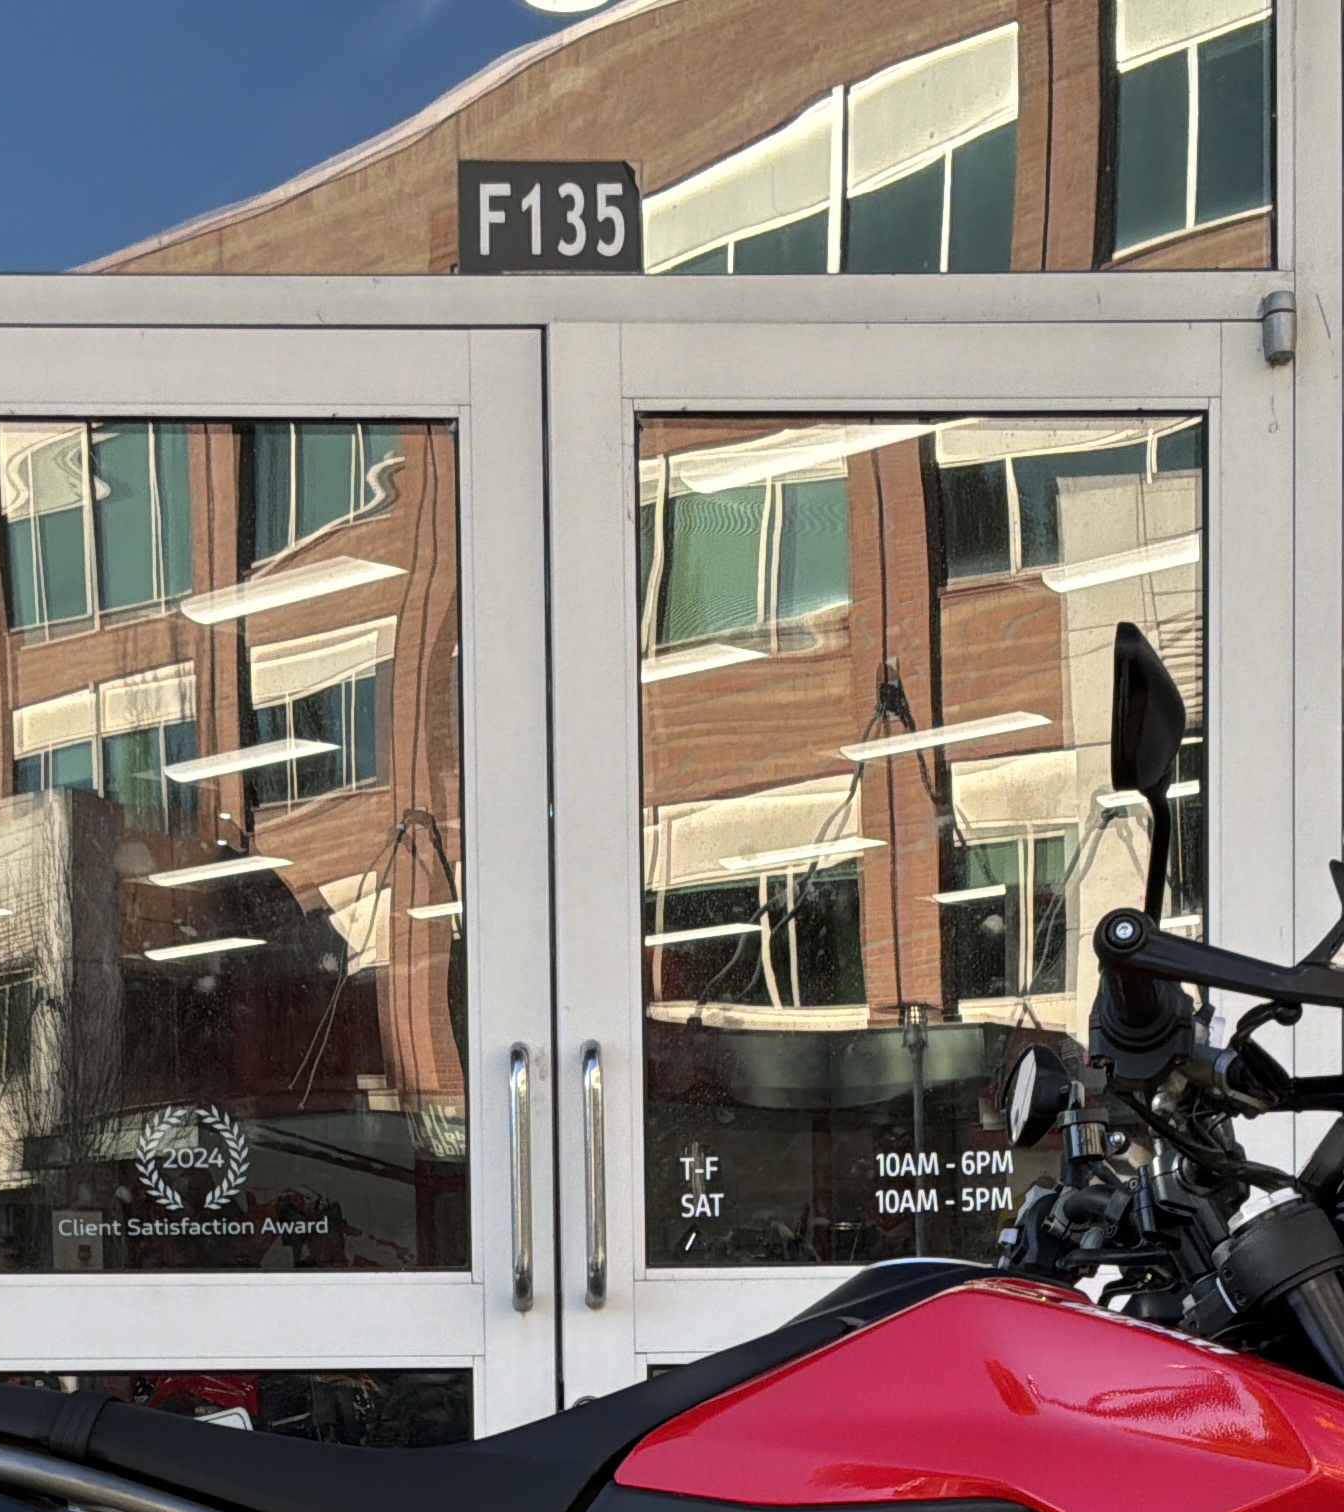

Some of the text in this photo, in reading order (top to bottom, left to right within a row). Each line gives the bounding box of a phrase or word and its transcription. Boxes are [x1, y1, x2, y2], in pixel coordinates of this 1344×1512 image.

[479, 181, 626, 257] F135
[163, 1148, 225, 1169] 2024
[680, 1157, 719, 1181] T-F
[875, 1152, 939, 1177] 10AM
[961, 1150, 1014, 1175] 6PM
[681, 1193, 725, 1218] SAT
[875, 1189, 939, 1214] 10AM
[961, 1187, 1014, 1212] 5PM
[58, 1216, 329, 1237] Client Satisfaction Award
